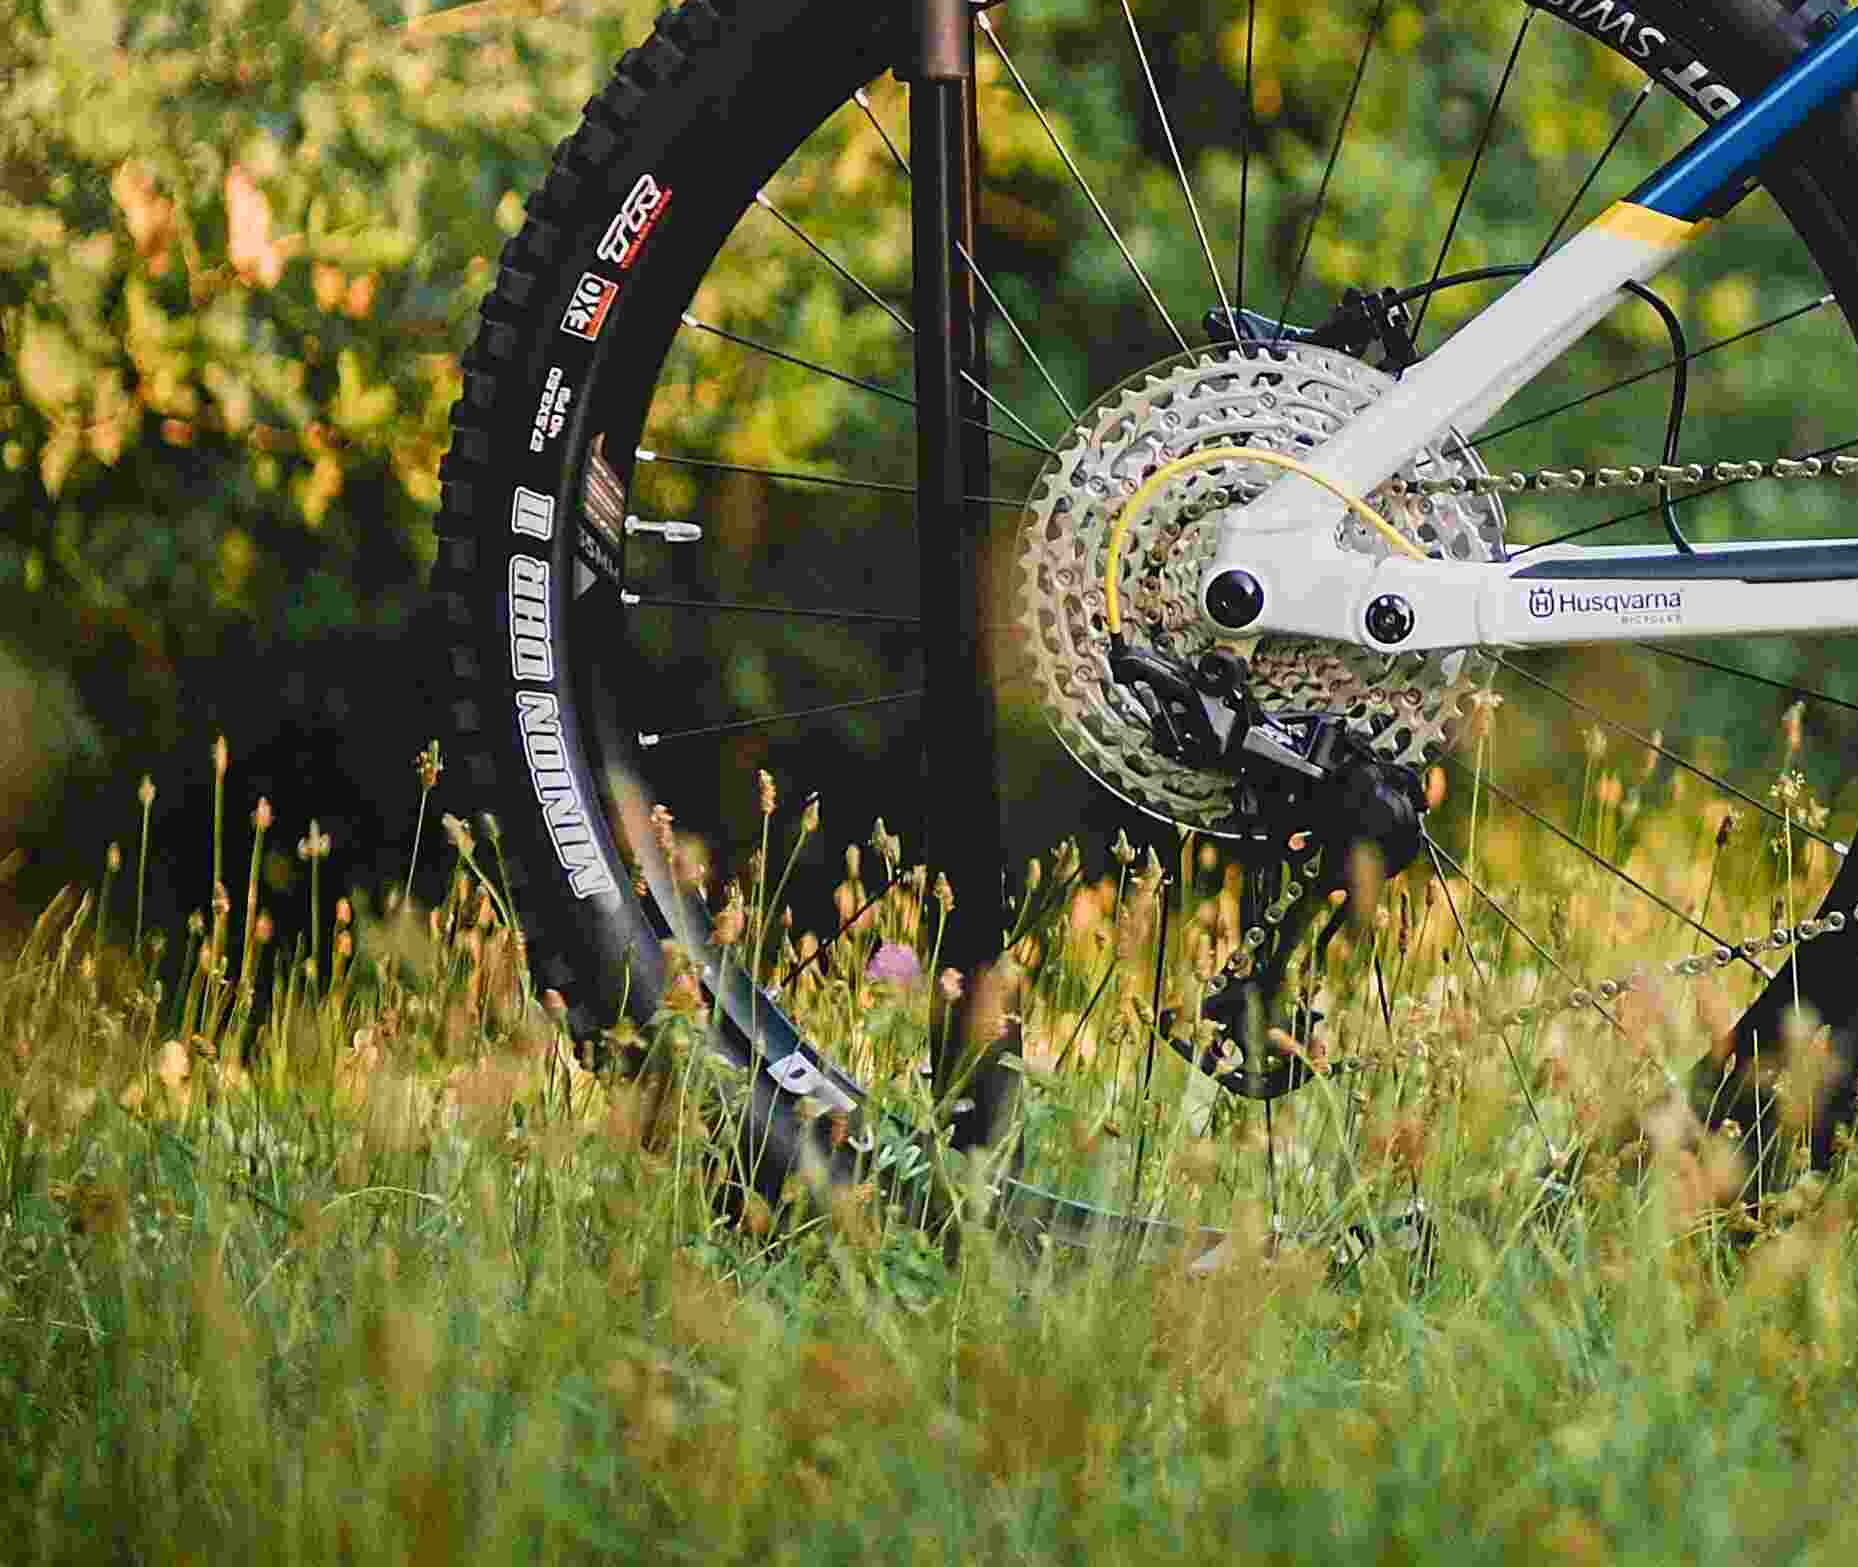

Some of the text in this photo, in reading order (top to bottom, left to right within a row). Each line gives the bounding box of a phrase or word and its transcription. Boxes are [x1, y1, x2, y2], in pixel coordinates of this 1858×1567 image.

[1660, 60, 1742, 120] DT
[596, 174, 661, 263] TR
[563, 274, 611, 335] EXO
[1559, 590, 1681, 615] Husqvarna
[509, 486, 620, 899] MINION DHR II
